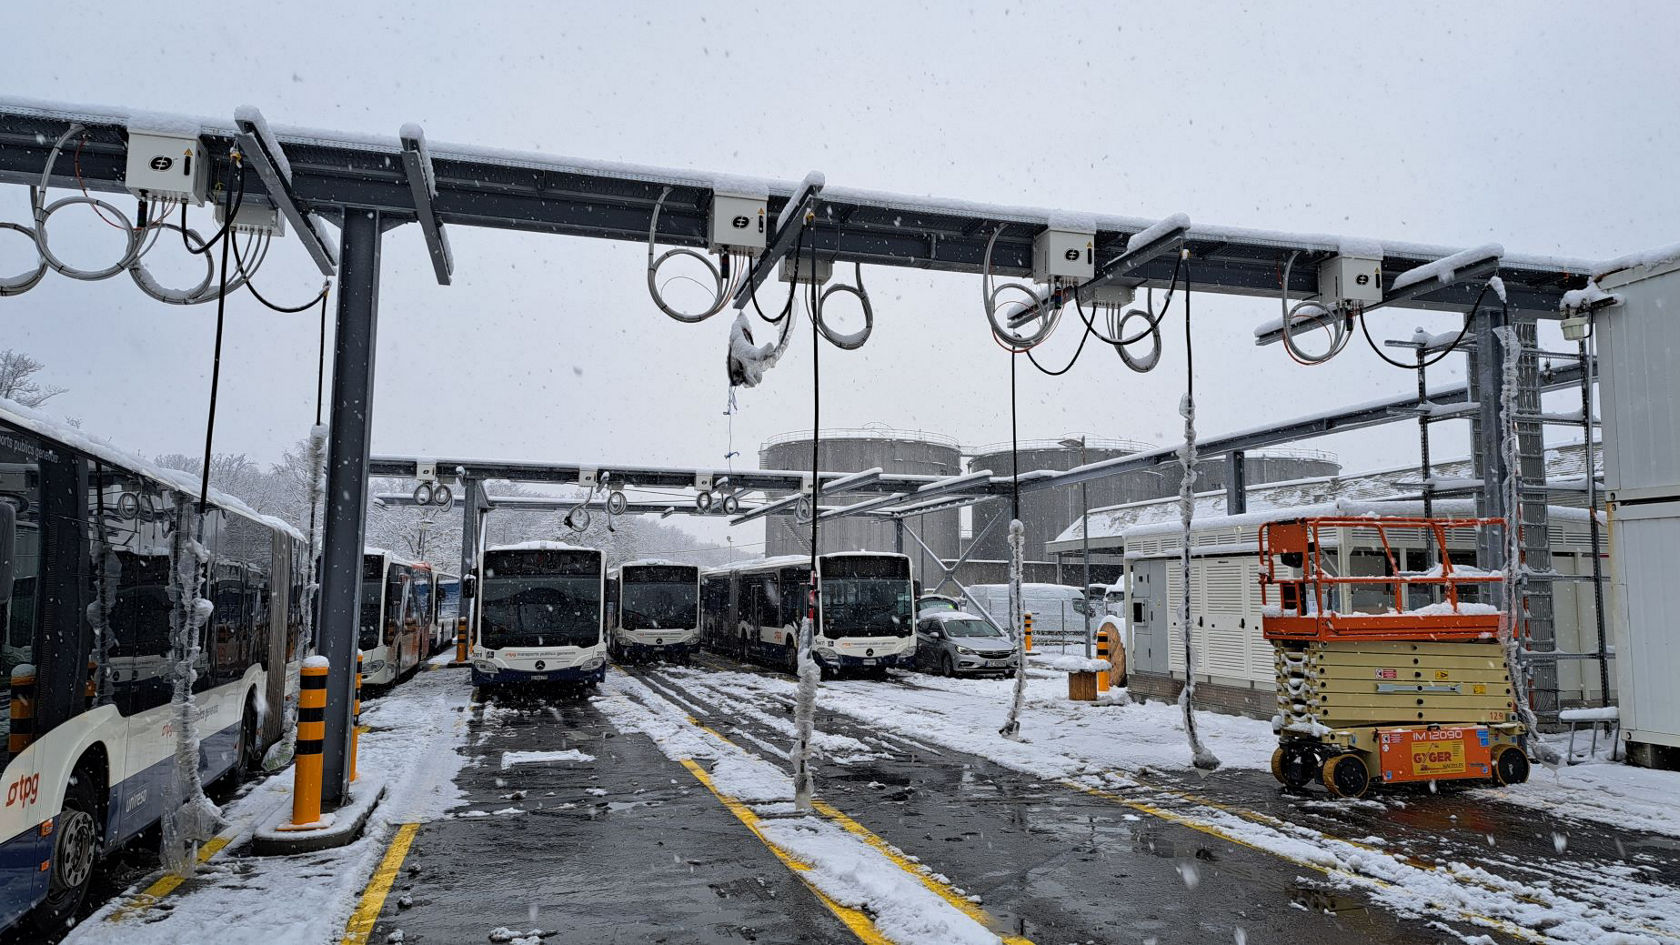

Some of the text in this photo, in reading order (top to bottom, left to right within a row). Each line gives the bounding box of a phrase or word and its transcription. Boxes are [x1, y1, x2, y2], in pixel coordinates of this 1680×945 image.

[1412, 732, 1426, 741] IM
[1428, 730, 1463, 740] 12090
[1413, 751, 1452, 764] GYGER
